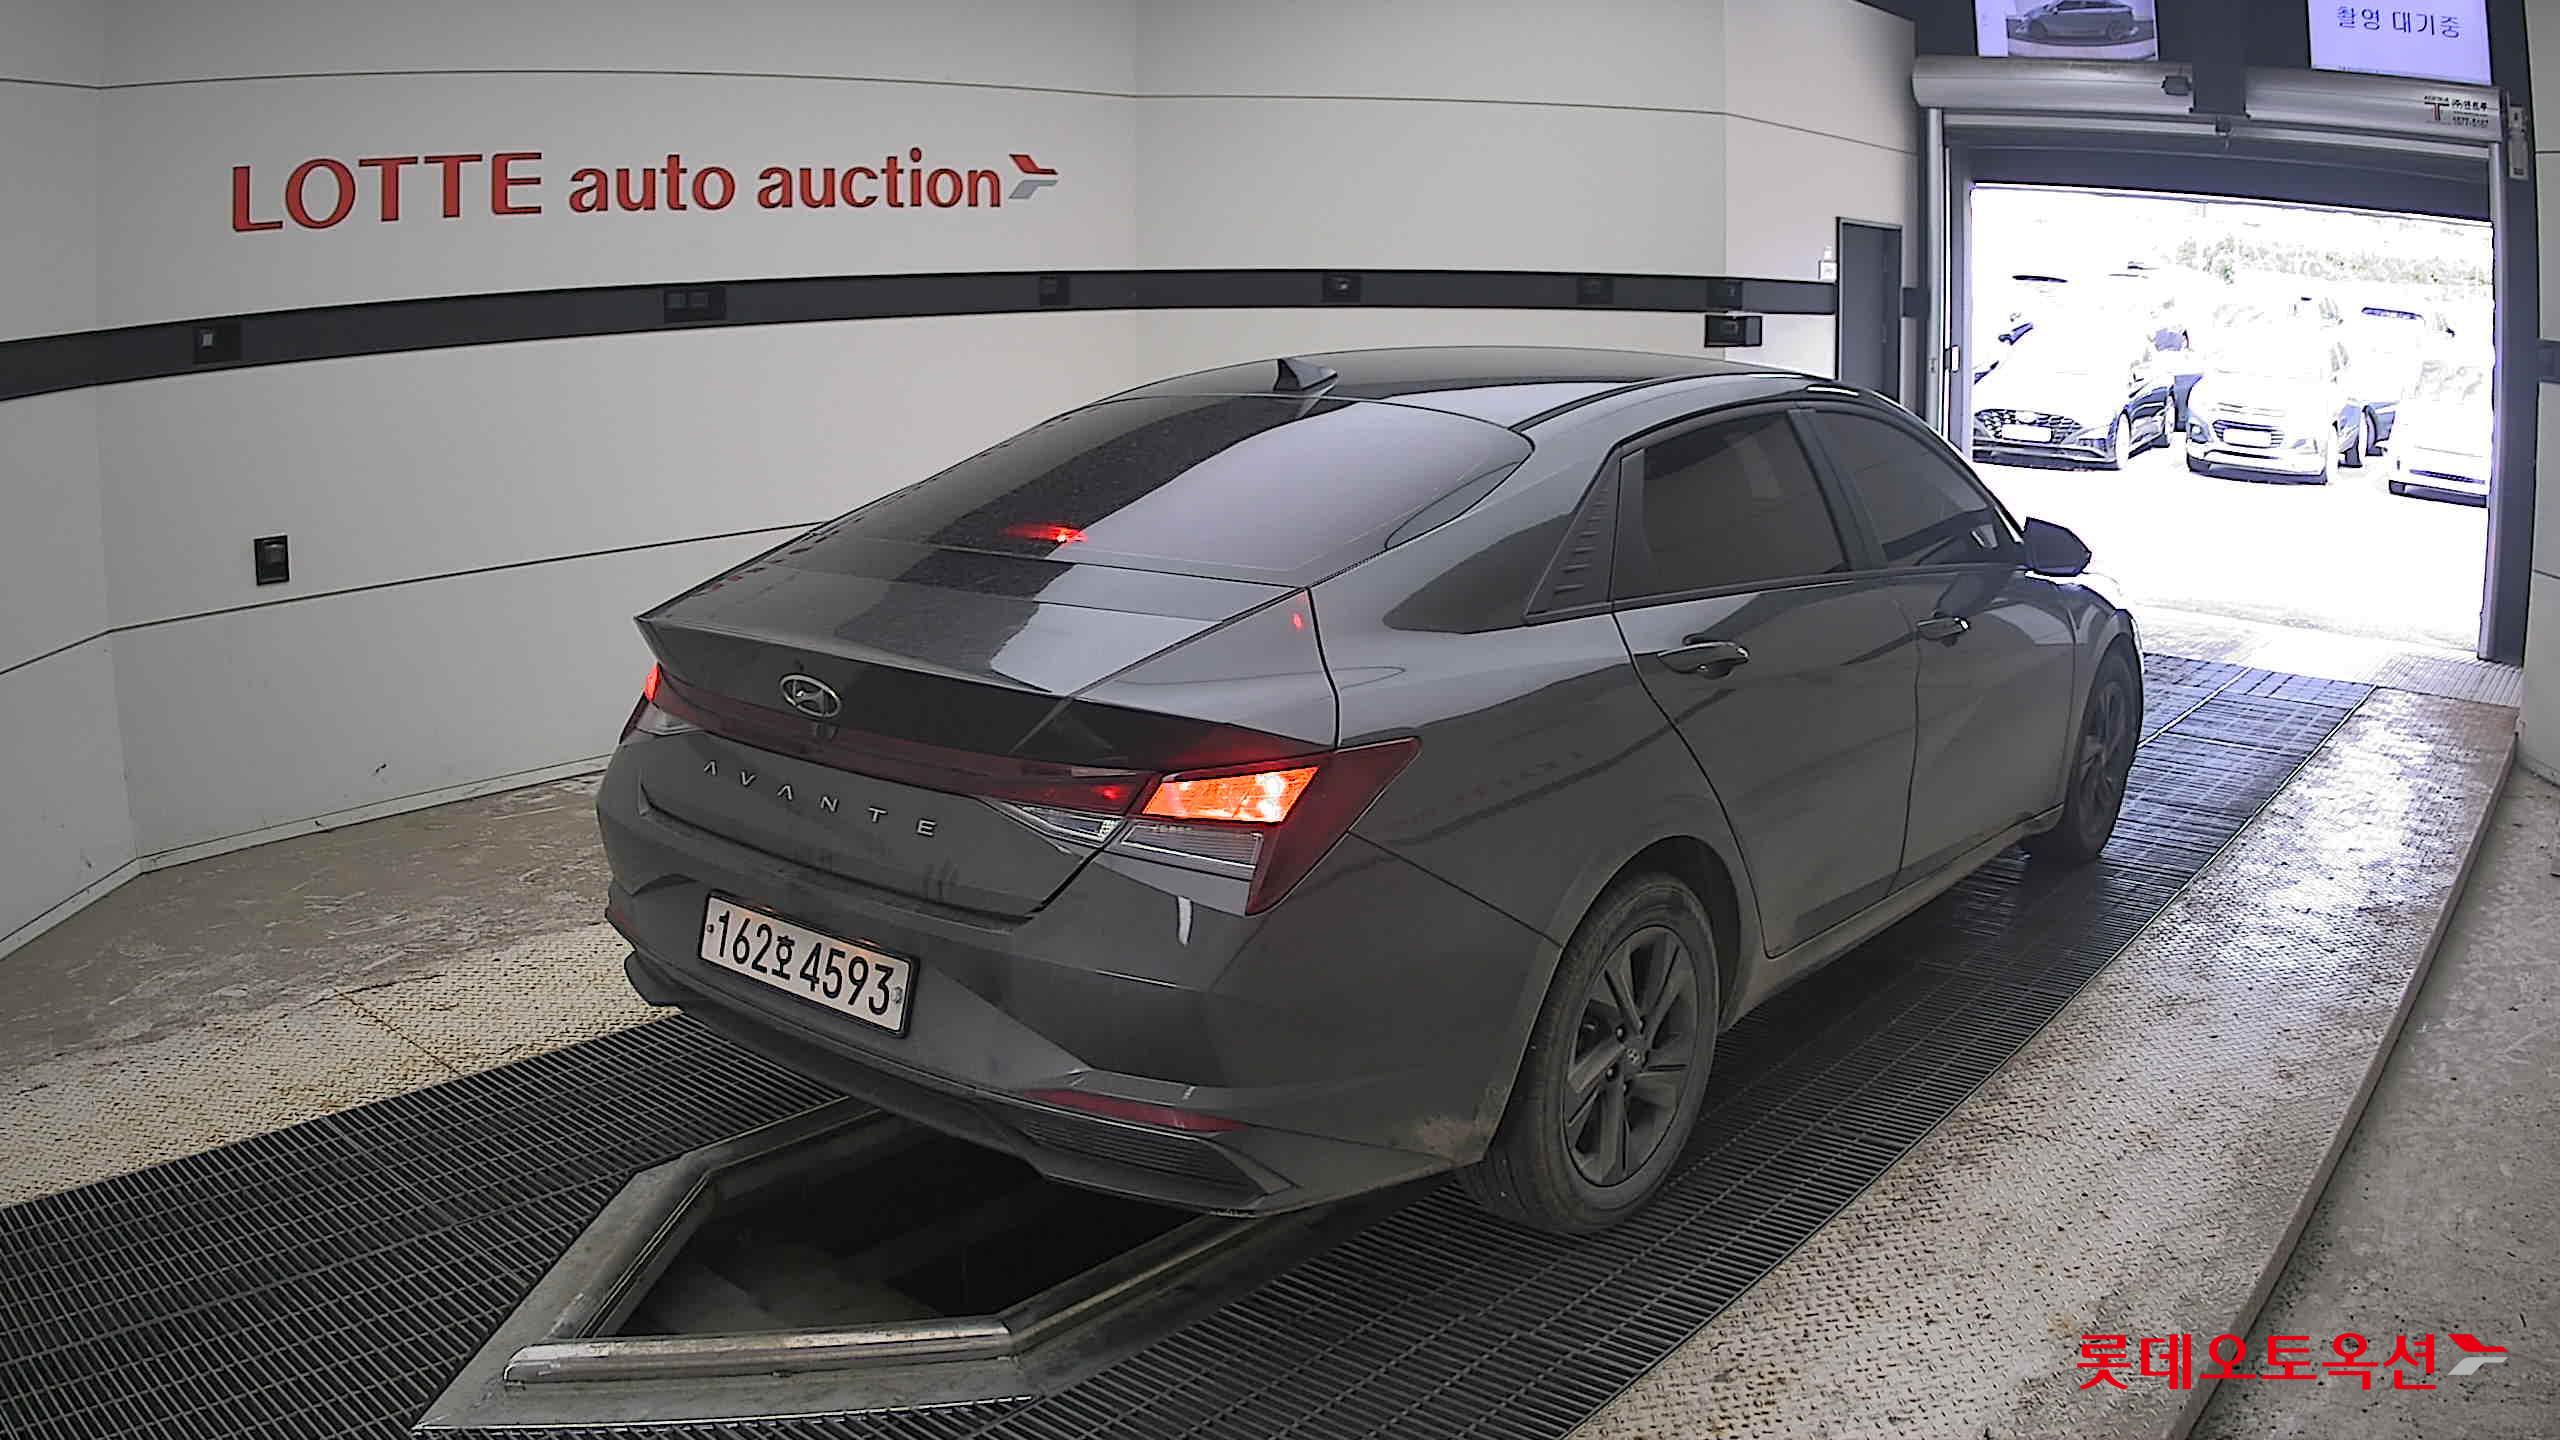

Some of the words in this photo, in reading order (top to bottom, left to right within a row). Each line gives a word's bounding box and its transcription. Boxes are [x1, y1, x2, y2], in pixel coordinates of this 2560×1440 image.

[2337, 5, 2380, 32] 촬영
[2393, 11, 2463, 39] 대기중
[232, 152, 543, 232] LOTTE
[568, 153, 736, 213] auto
[757, 147, 1002, 211] auction
[703, 759, 937, 837] AVANTE
